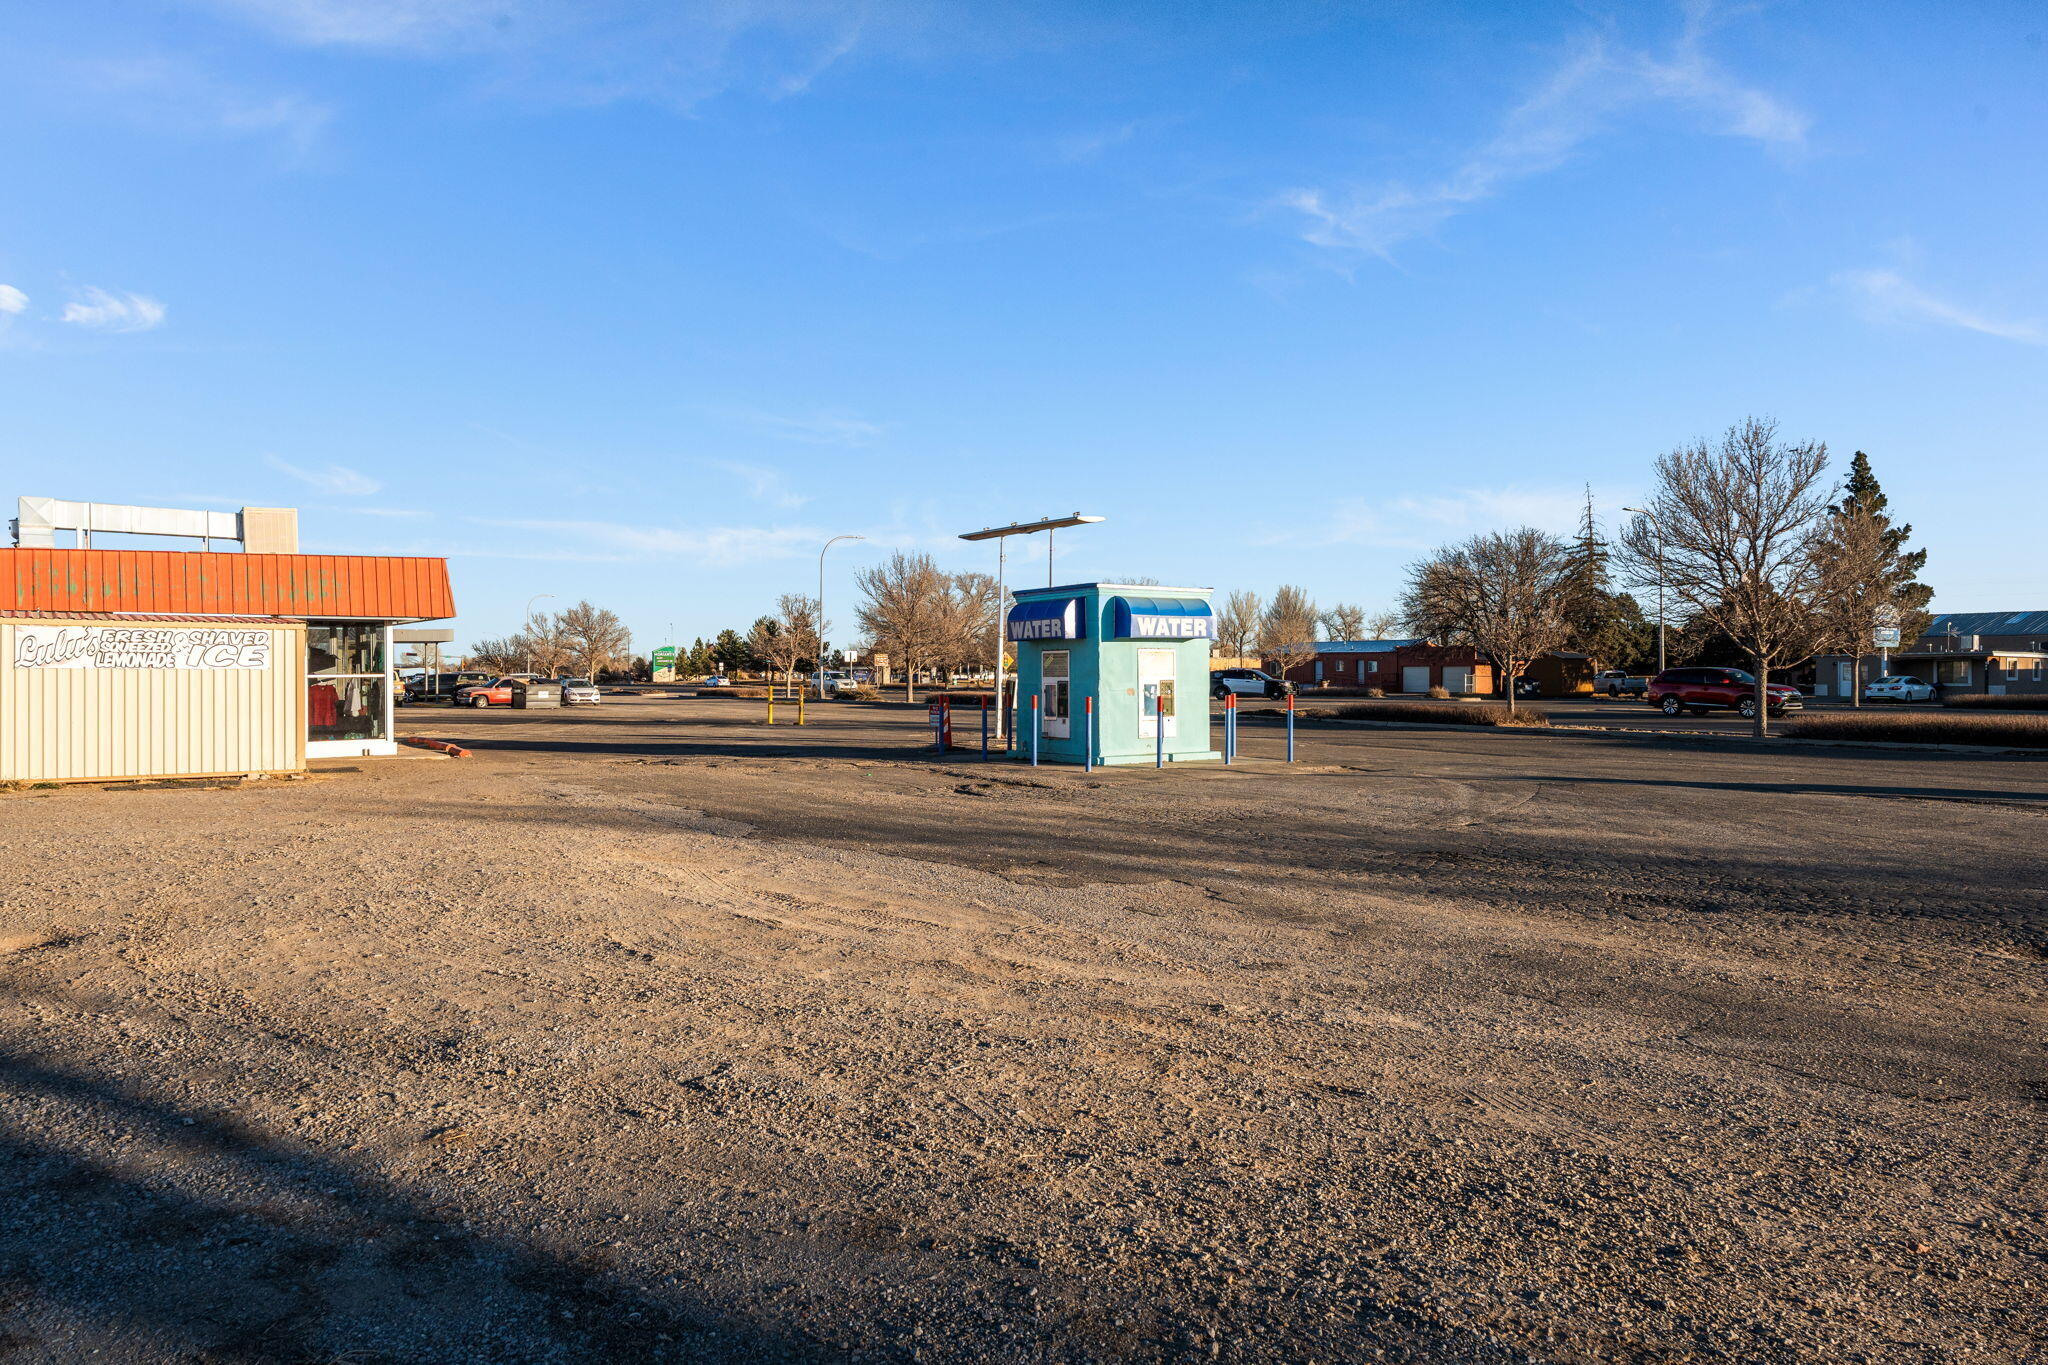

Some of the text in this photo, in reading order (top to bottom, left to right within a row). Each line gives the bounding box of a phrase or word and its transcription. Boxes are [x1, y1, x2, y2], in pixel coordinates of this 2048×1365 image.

[100, 629, 173, 643] FRESH
[1010, 618, 1062, 638] WATER
[1137, 617, 1207, 637] WATER
[15, 626, 99, 668] Lulu's
[99, 641, 172, 653] SQUEEZED
[172, 632, 189, 657] &
[188, 631, 268, 645] SHAVED
[94, 652, 175, 668] LEMONADE
[186, 644, 269, 667] ICE
